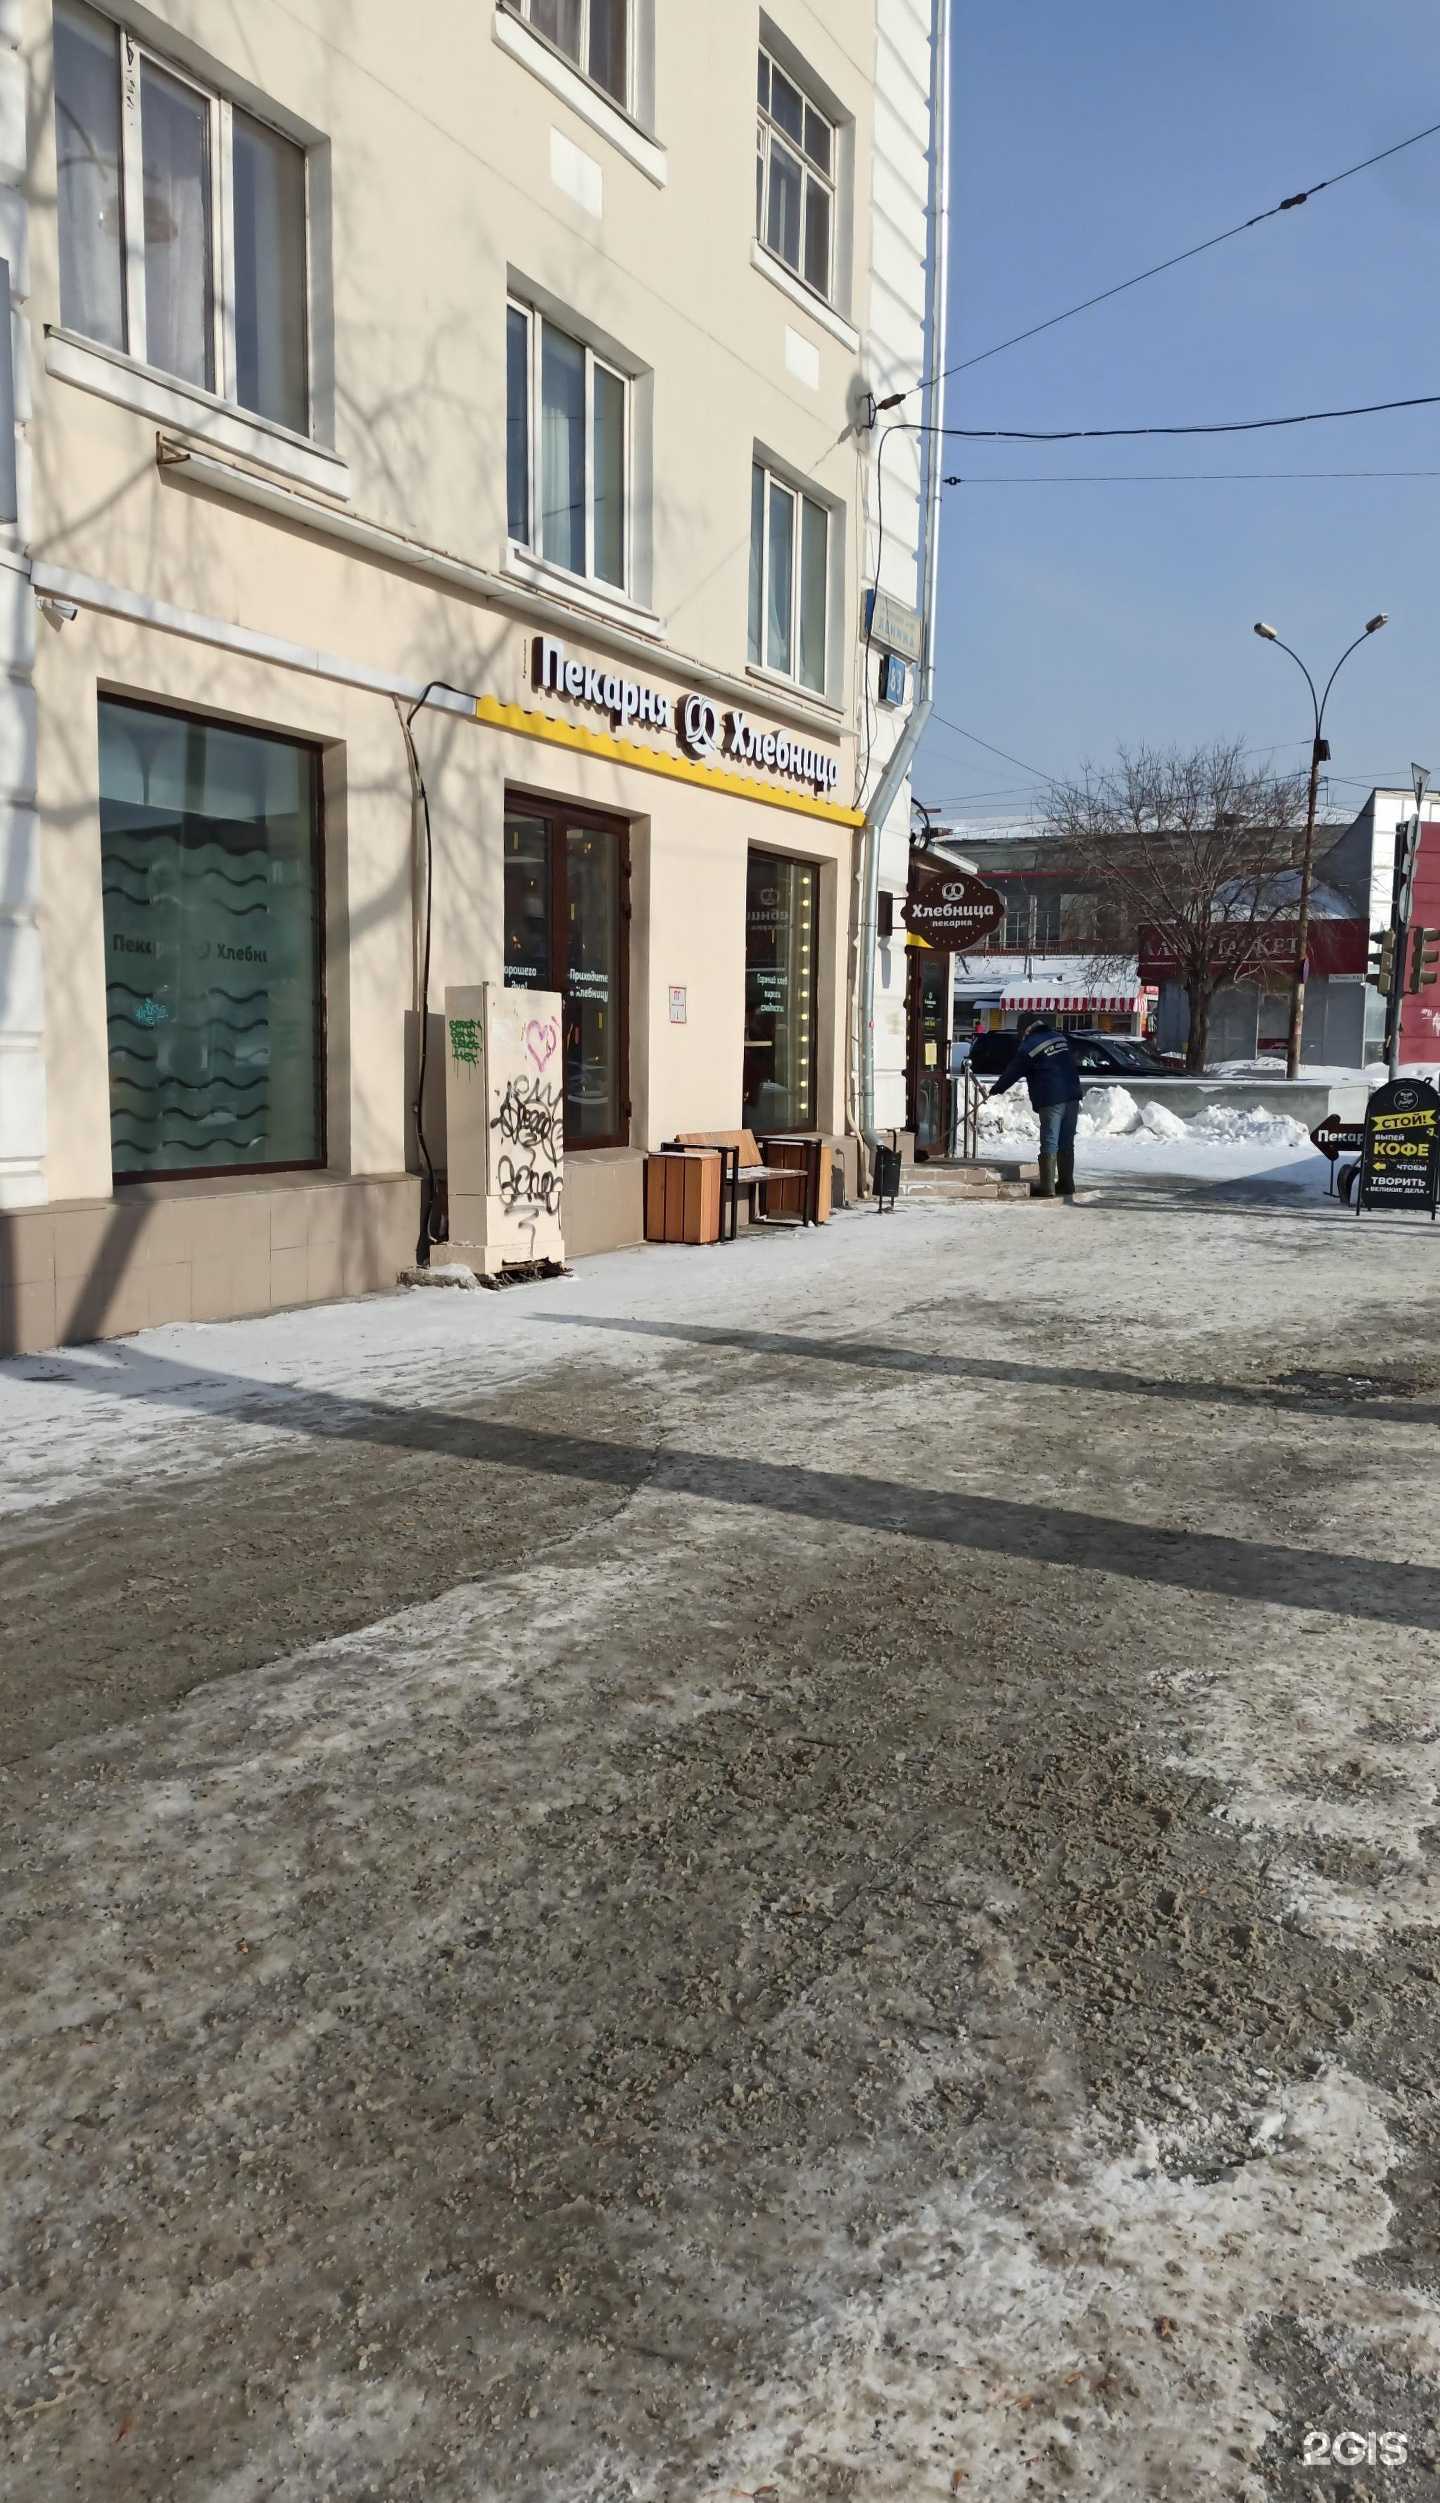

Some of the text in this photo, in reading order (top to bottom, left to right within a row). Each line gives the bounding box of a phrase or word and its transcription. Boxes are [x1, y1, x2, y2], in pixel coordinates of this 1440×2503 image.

[541, 638, 839, 793] Пекарня Хлебница
[911, 903, 994, 919] Хлебница
[932, 919, 973, 928] пекарня
[569, 968, 609, 983] Приходите
[1382, 1113, 1427, 1129] СТОЙ!
[1374, 1133, 1405, 1141] ВЫПЕЙ
[1373, 1142, 1430, 1157] КОФЕ
[1371, 1176, 1426, 1187] ТВОРИТЬ
